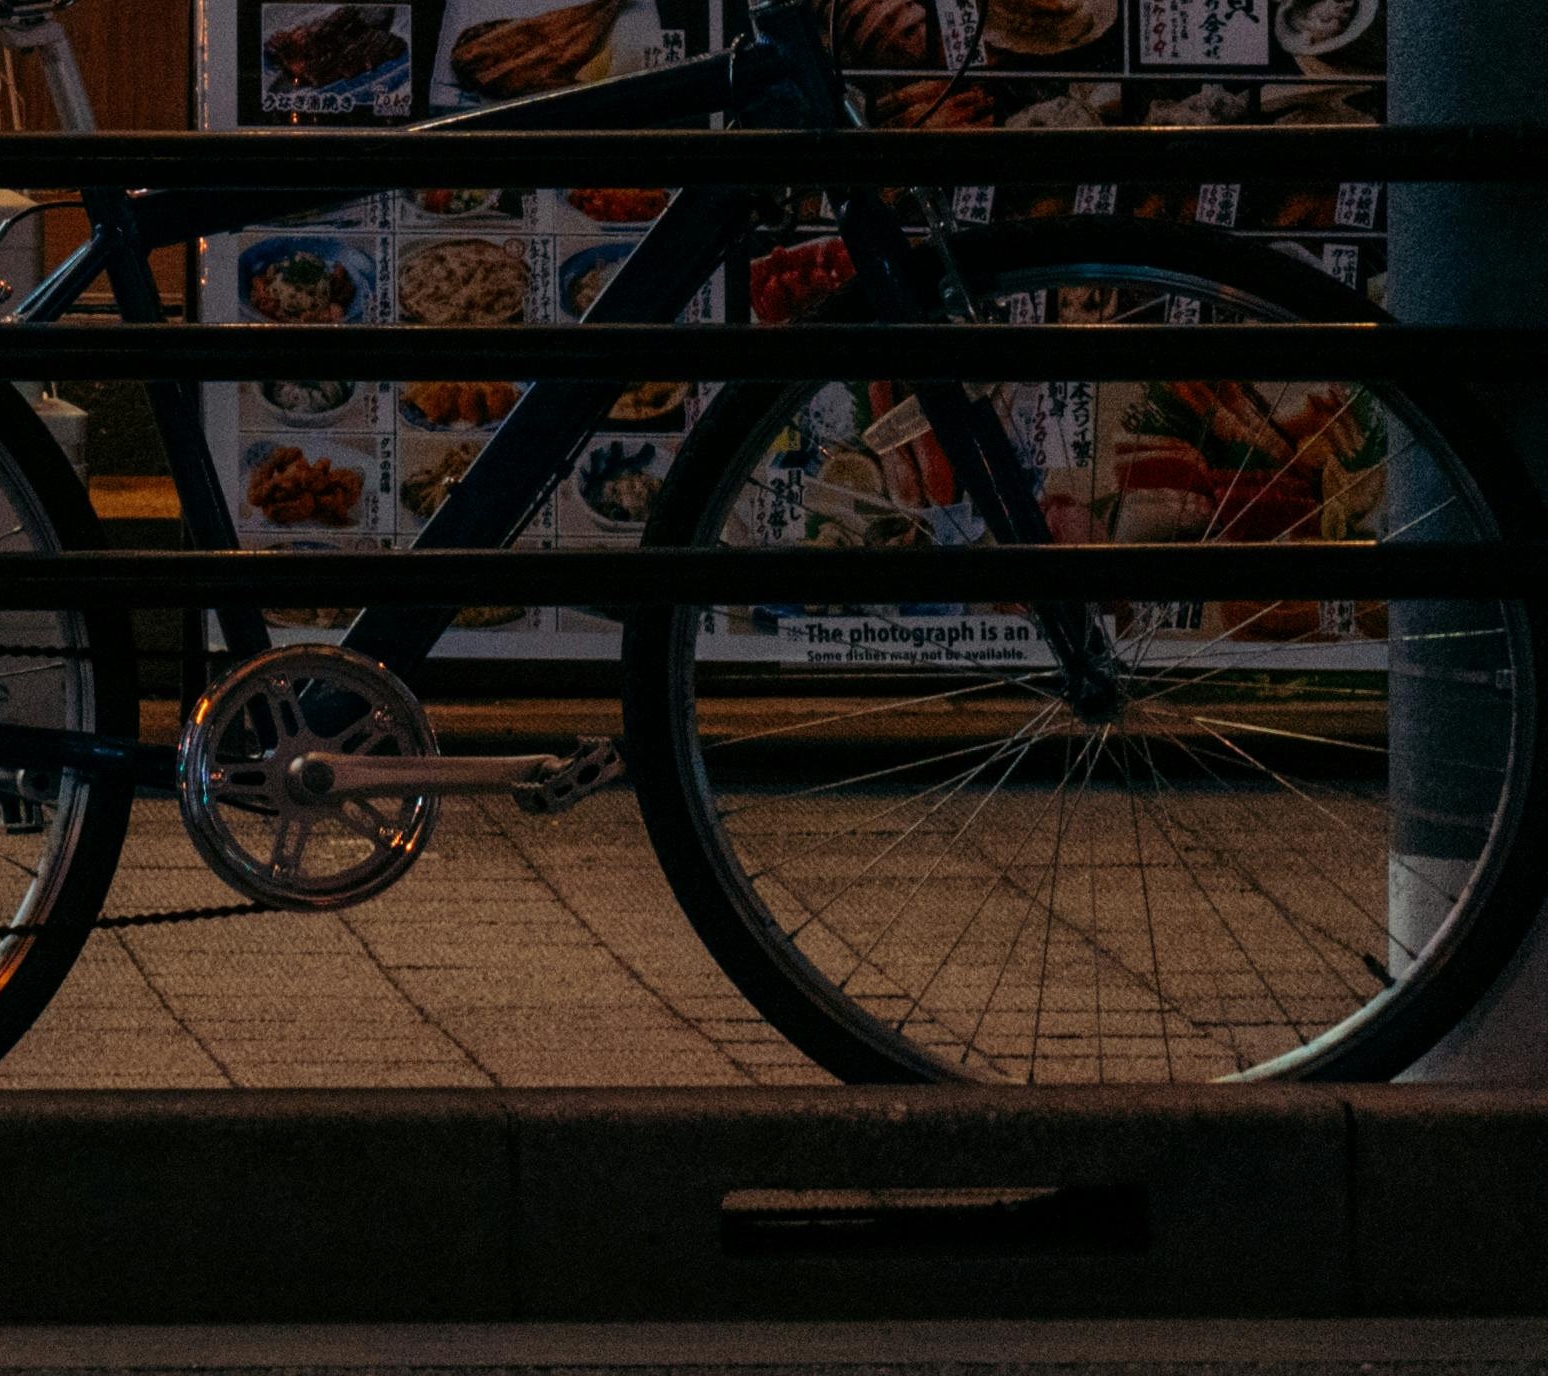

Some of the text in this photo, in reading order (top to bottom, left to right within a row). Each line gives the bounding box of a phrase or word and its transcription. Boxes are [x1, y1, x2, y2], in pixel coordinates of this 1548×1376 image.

[806, 624, 1029, 647] The photograph is an
[807, 651, 842, 662] Some
